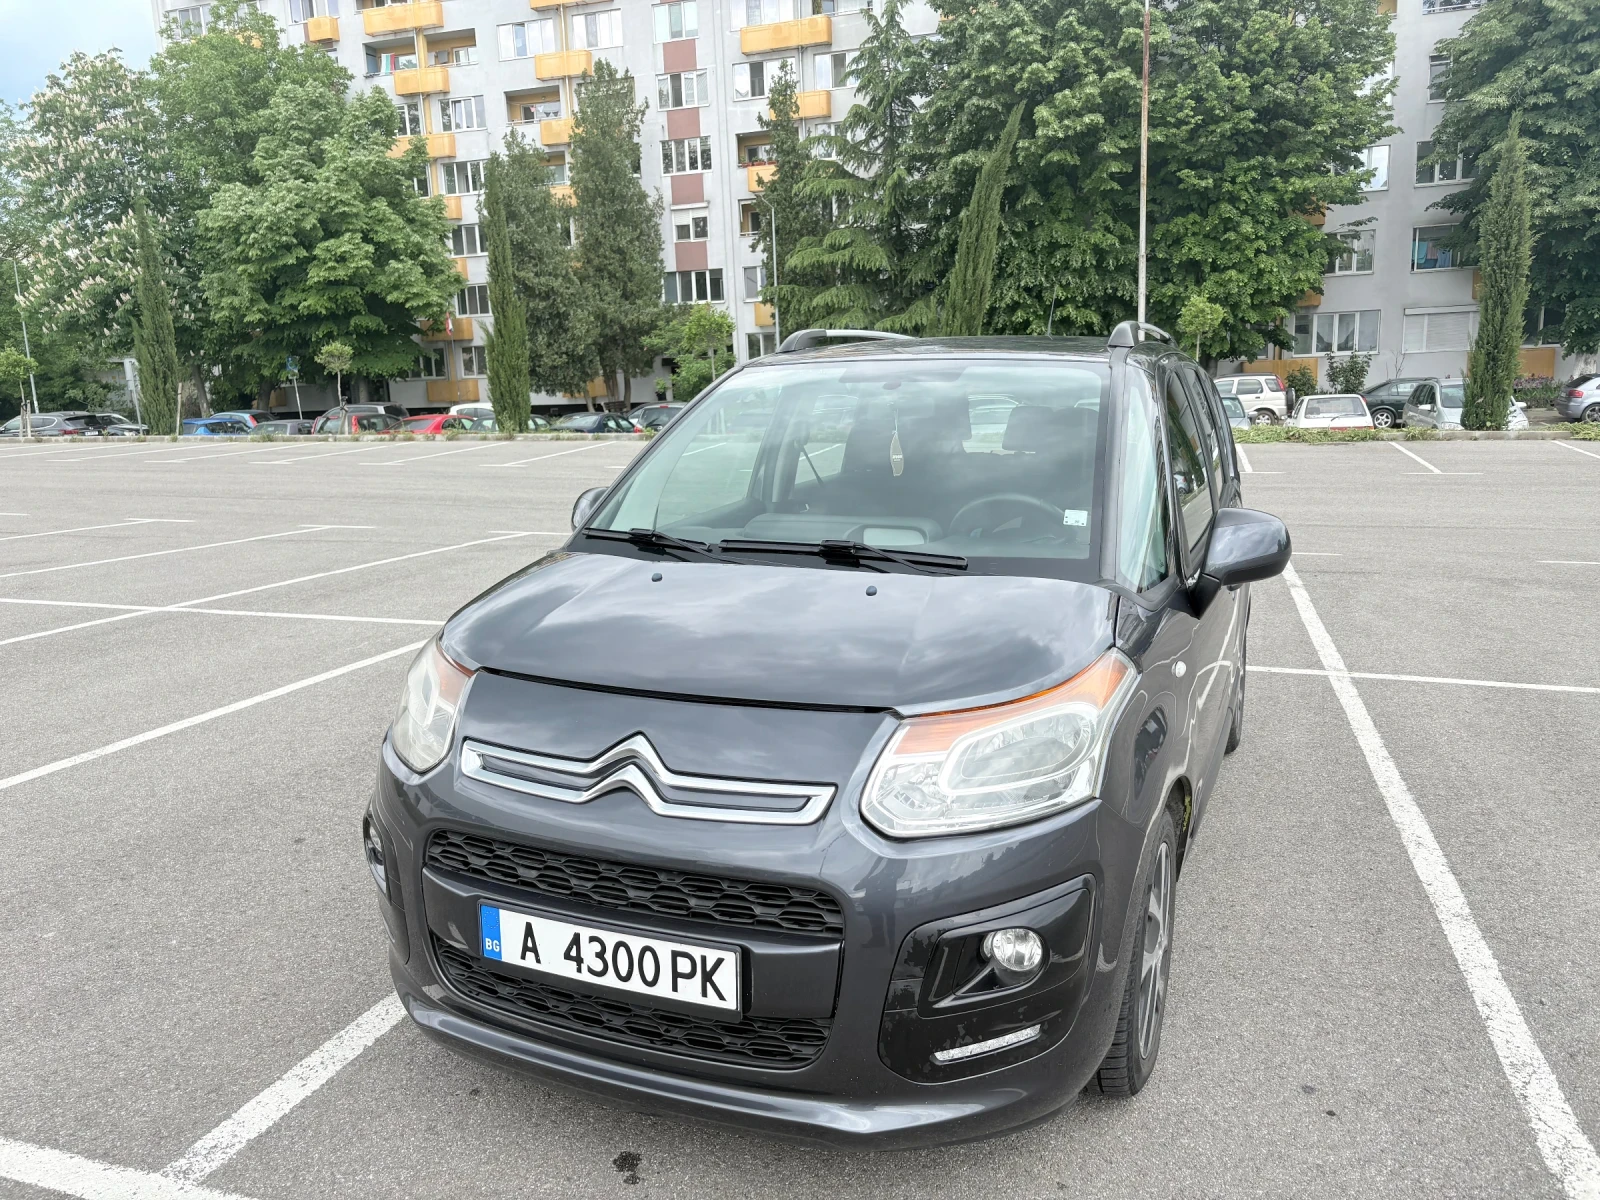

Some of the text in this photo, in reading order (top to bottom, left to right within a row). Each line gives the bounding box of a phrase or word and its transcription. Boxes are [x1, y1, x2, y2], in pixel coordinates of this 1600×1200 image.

[485, 937, 500, 952] BG
[520, 921, 728, 1002] A 4300 PK
